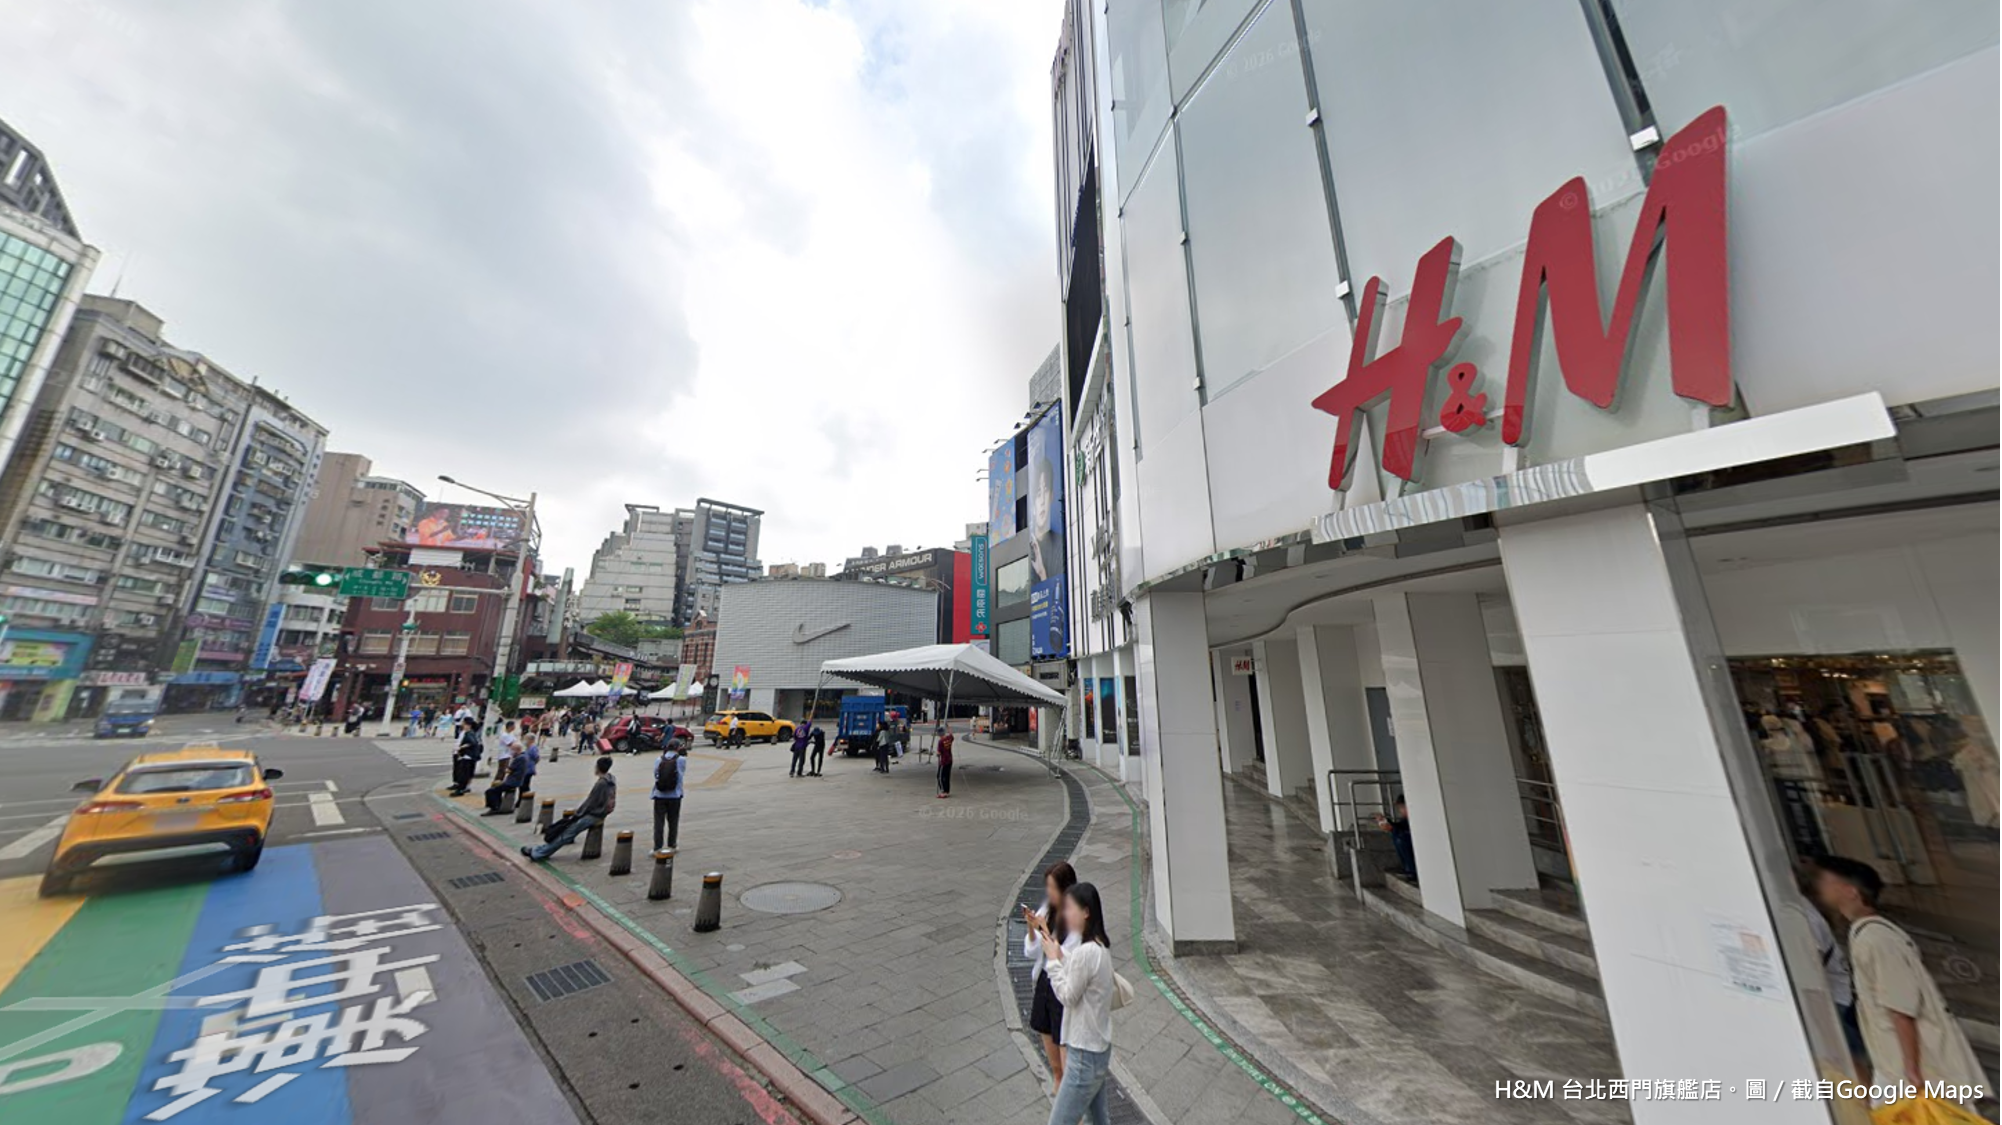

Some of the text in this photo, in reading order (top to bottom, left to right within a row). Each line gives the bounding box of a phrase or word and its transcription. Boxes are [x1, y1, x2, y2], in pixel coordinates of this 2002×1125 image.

[1311, 104, 1731, 490] H&M
[888, 553, 932, 570] ARMOUR
[976, 589, 986, 618] 屈臣氏
[144, 902, 444, 1121] 漢中街
